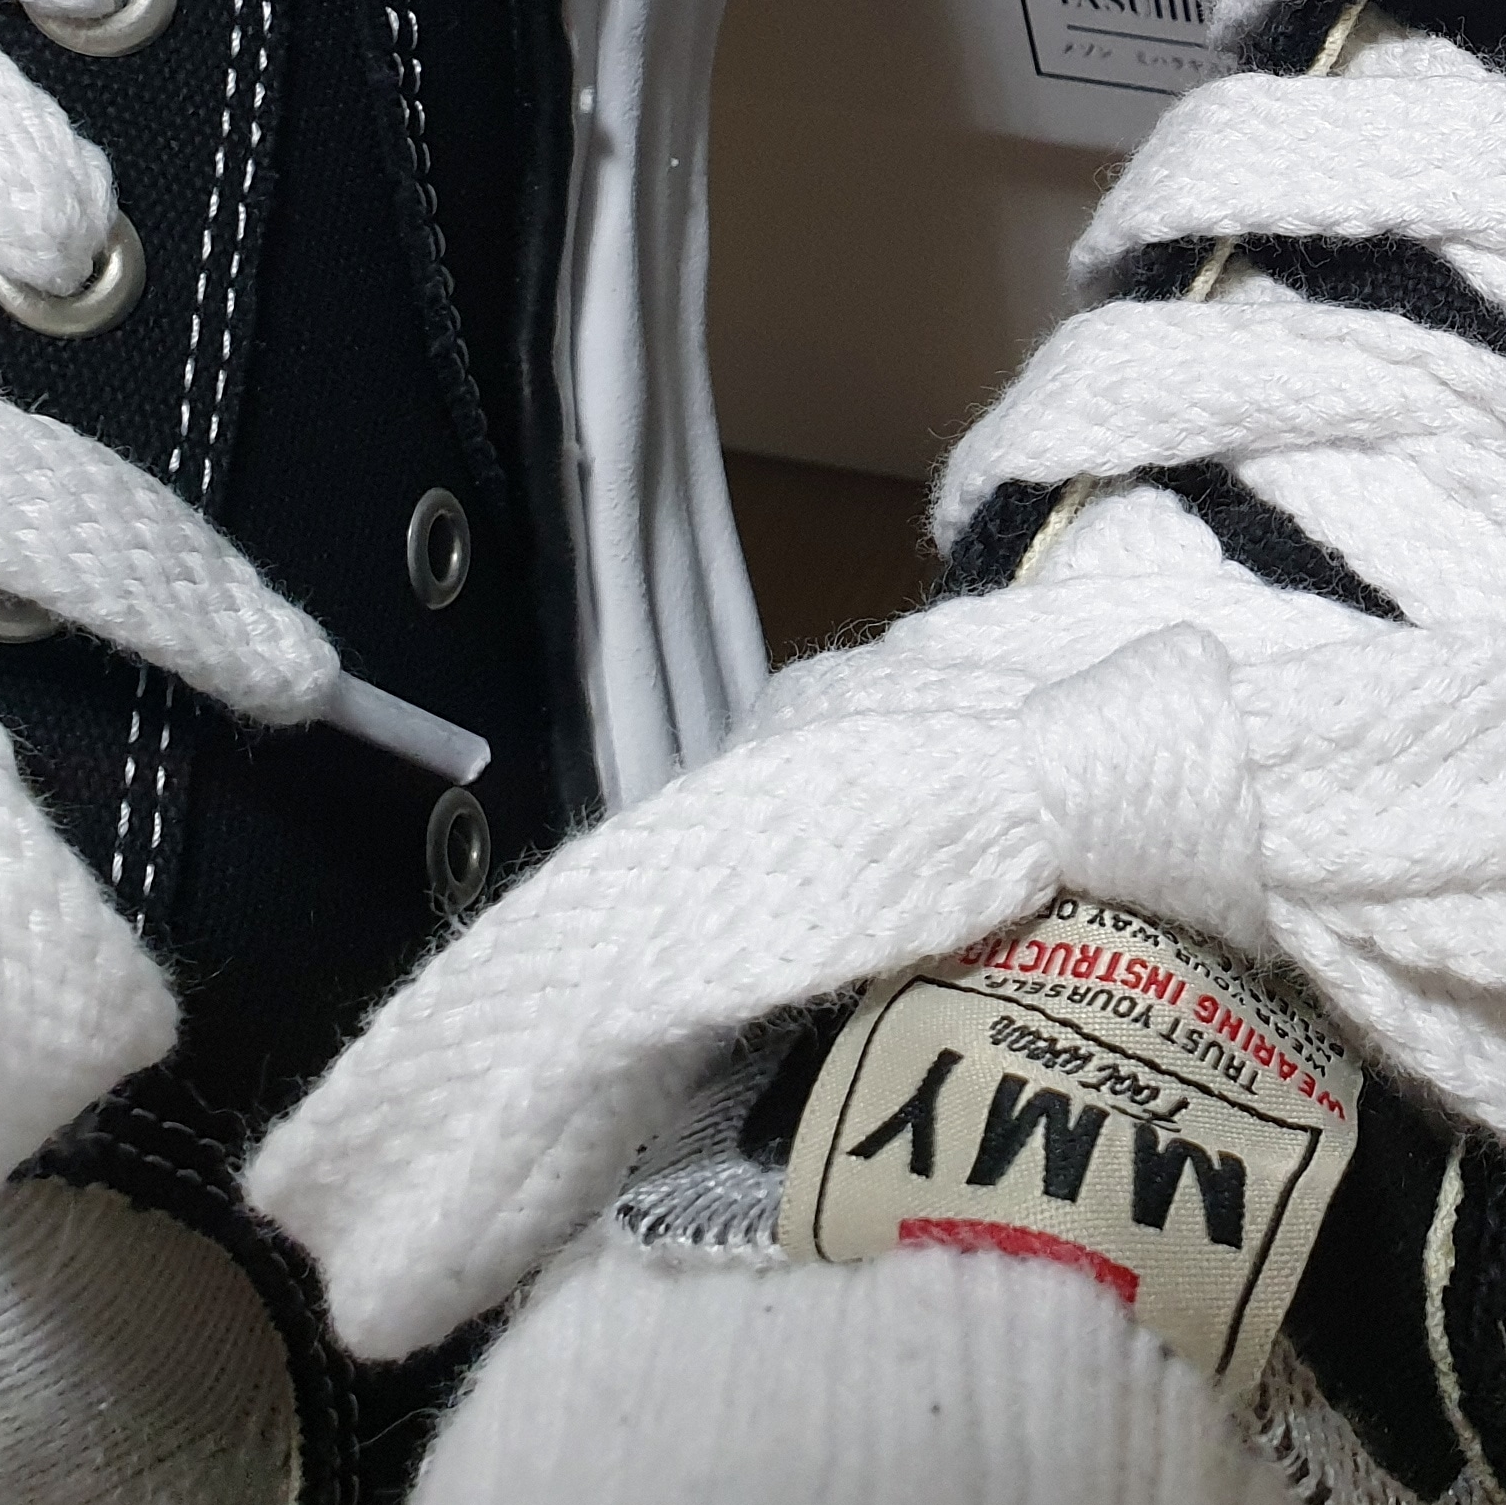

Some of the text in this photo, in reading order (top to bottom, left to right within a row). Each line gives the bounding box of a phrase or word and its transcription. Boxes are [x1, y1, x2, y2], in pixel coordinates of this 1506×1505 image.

[1086, 907, 1161, 948] WAY
[1159, 1017, 1259, 1096] TRUST
[1193, 993, 1346, 1121] WEARING
[845, 1046, 1247, 1251] MMY
